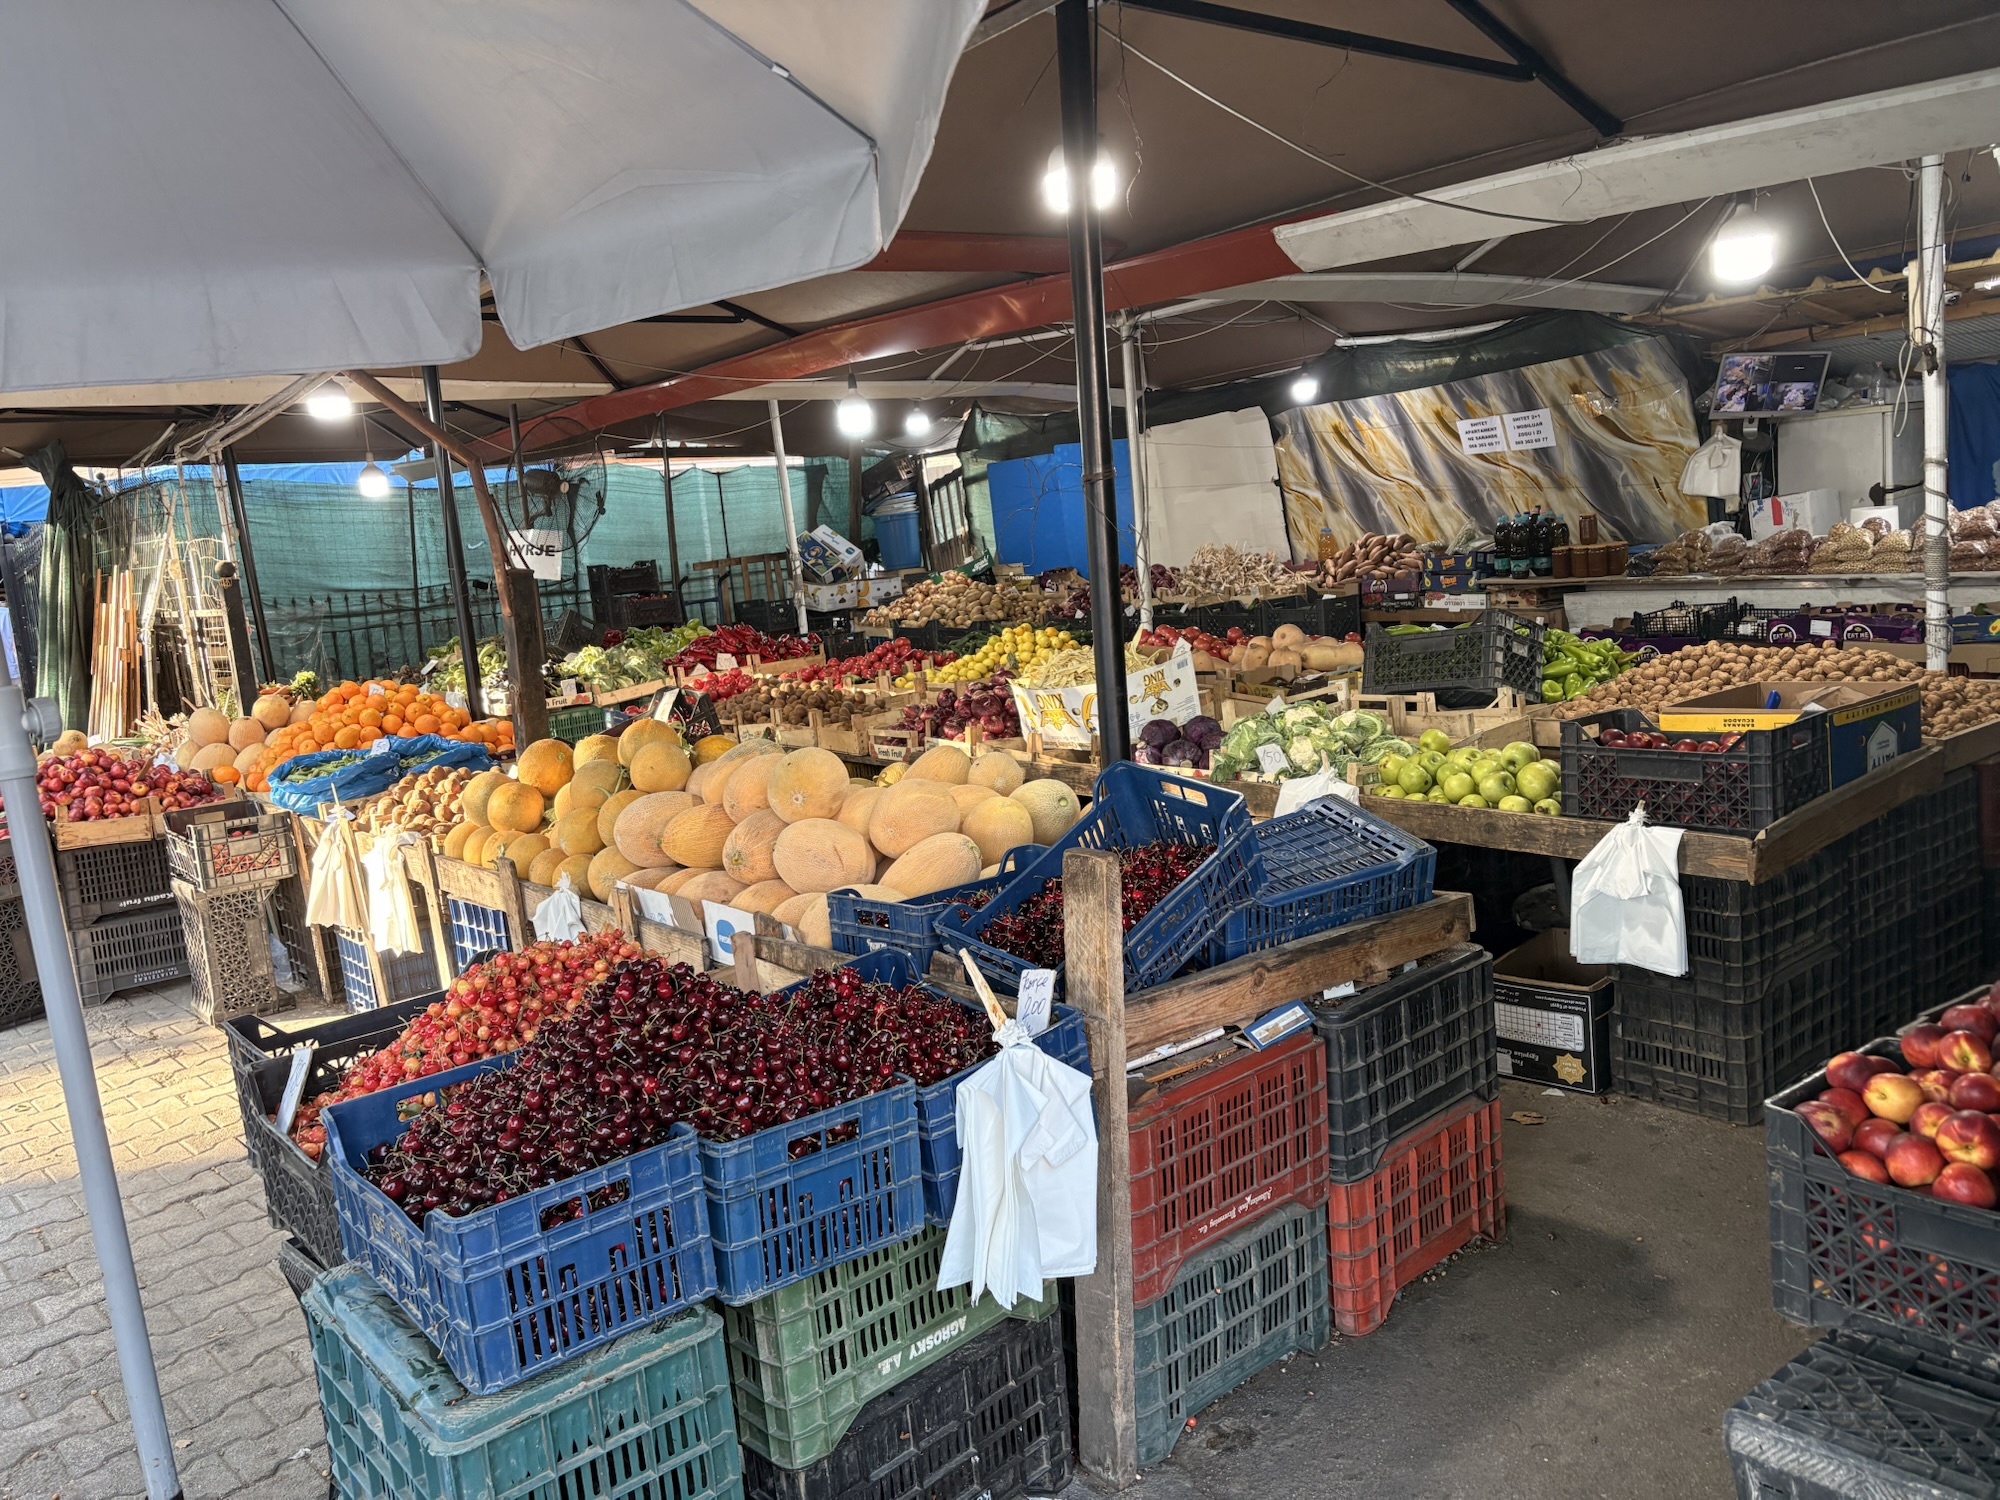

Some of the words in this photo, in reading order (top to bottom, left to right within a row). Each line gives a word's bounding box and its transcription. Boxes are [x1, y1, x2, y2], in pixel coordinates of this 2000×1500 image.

[510, 544, 556, 556] HYRJE
[1143, 668, 1166, 687] KING
[1036, 693, 1066, 710] KING
[1845, 705, 1880, 719] QUALITY
[1160, 894, 1197, 937] FRUIT
[1022, 994, 1046, 1020] 200
[1514, 1051, 1539, 1061] Egyptian
[909, 1315, 967, 1360] AGROSKY
